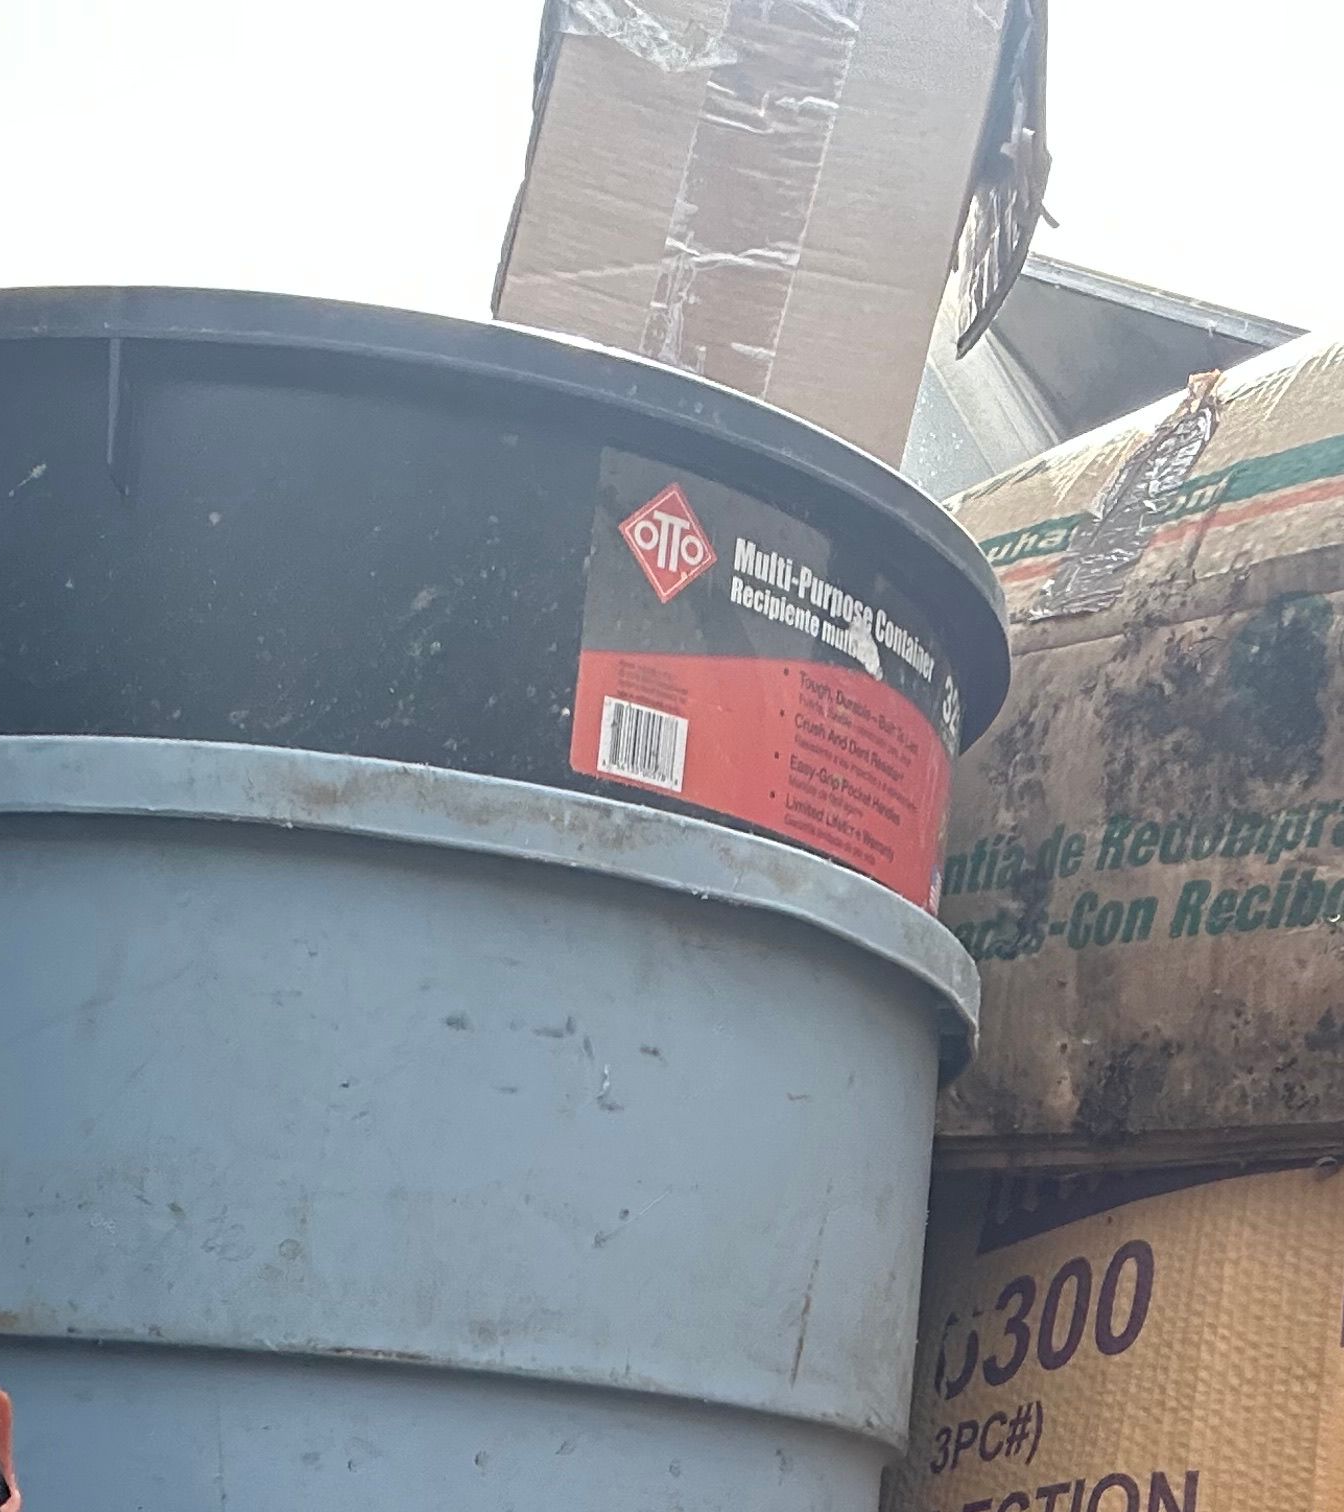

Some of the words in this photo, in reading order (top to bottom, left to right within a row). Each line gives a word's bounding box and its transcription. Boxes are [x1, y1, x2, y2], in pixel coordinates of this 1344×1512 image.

[633, 509, 705, 573] OTTO
[730, 576, 820, 638] Recipiente
[734, 538, 874, 628] Multi-Purpose
[875, 608, 935, 683] Container
[794, 712, 826, 739] Crush
